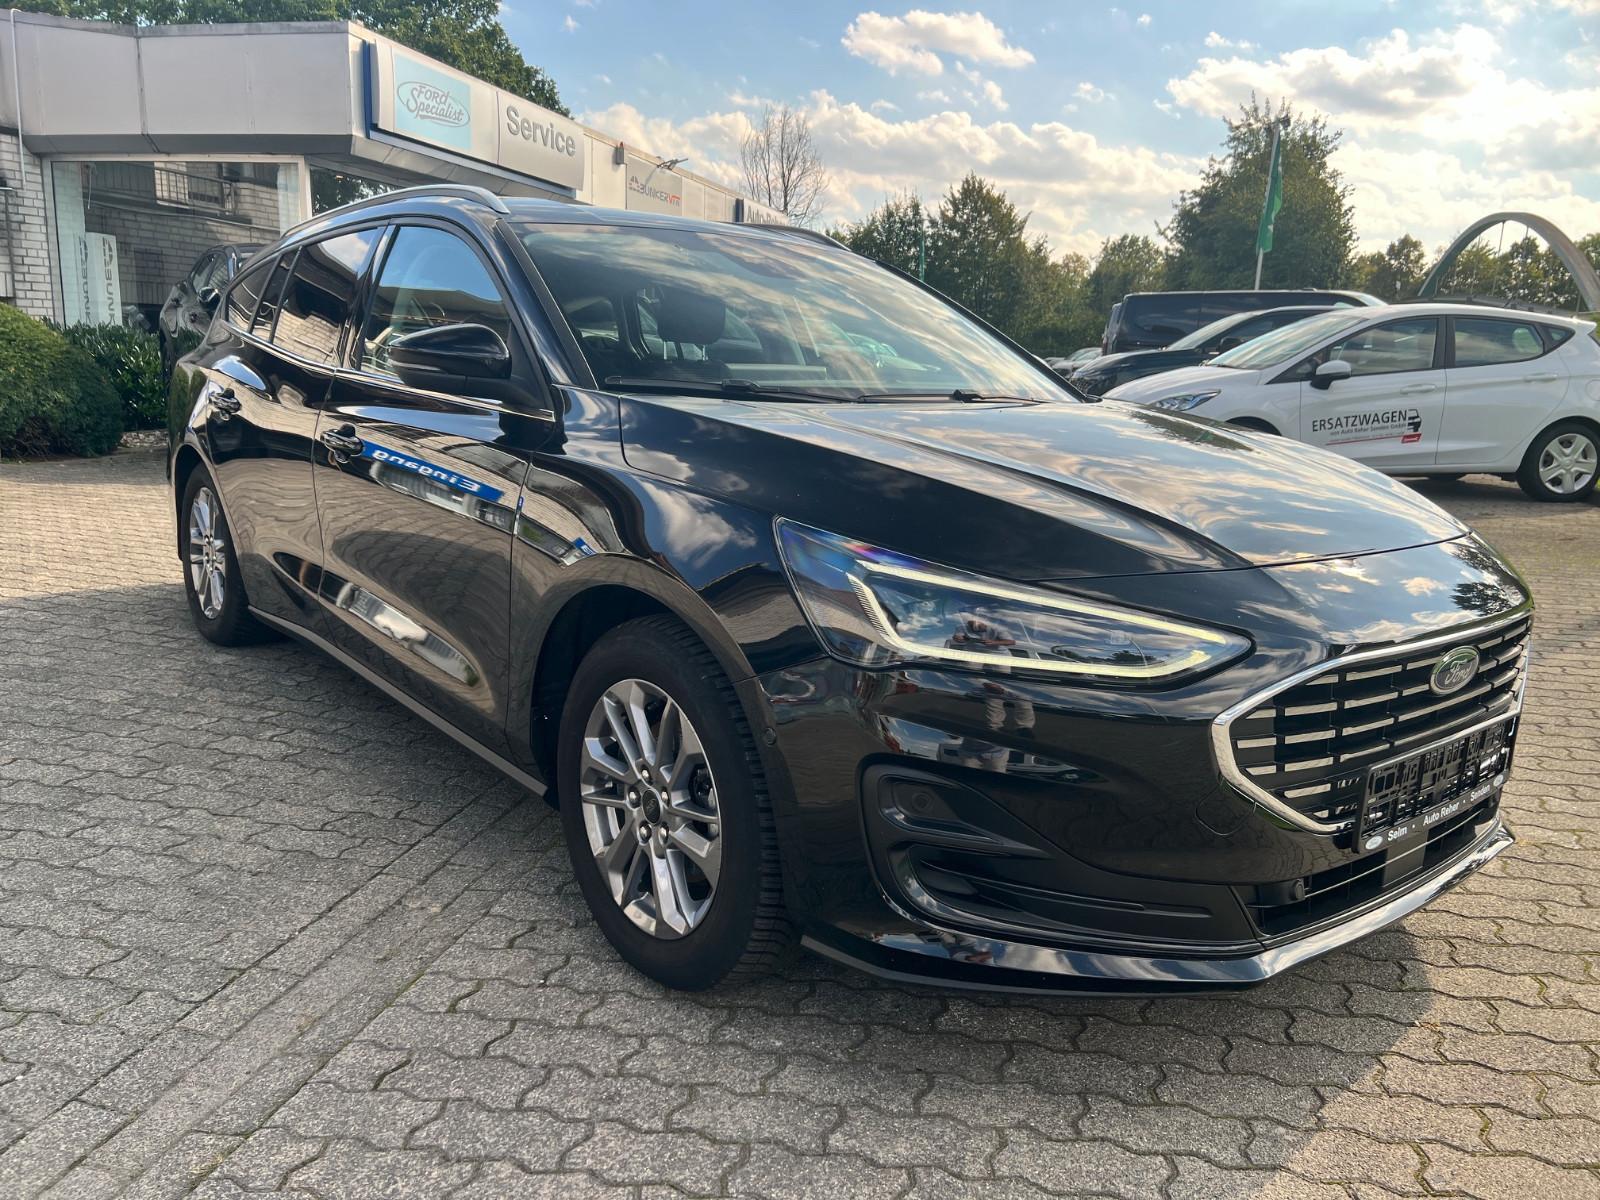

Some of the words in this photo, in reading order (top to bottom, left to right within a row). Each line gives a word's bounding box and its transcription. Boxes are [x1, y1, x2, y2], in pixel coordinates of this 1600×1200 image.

[406, 87, 465, 122] Specialist
[506, 105, 576, 157] Service
[1312, 410, 1407, 432] ERSATZWAGEN
[1444, 658, 1473, 685] Ford
[1387, 826, 1408, 841] Selm
[1422, 812, 1440, 827] Auto
[1440, 802, 1460, 818] Reher
